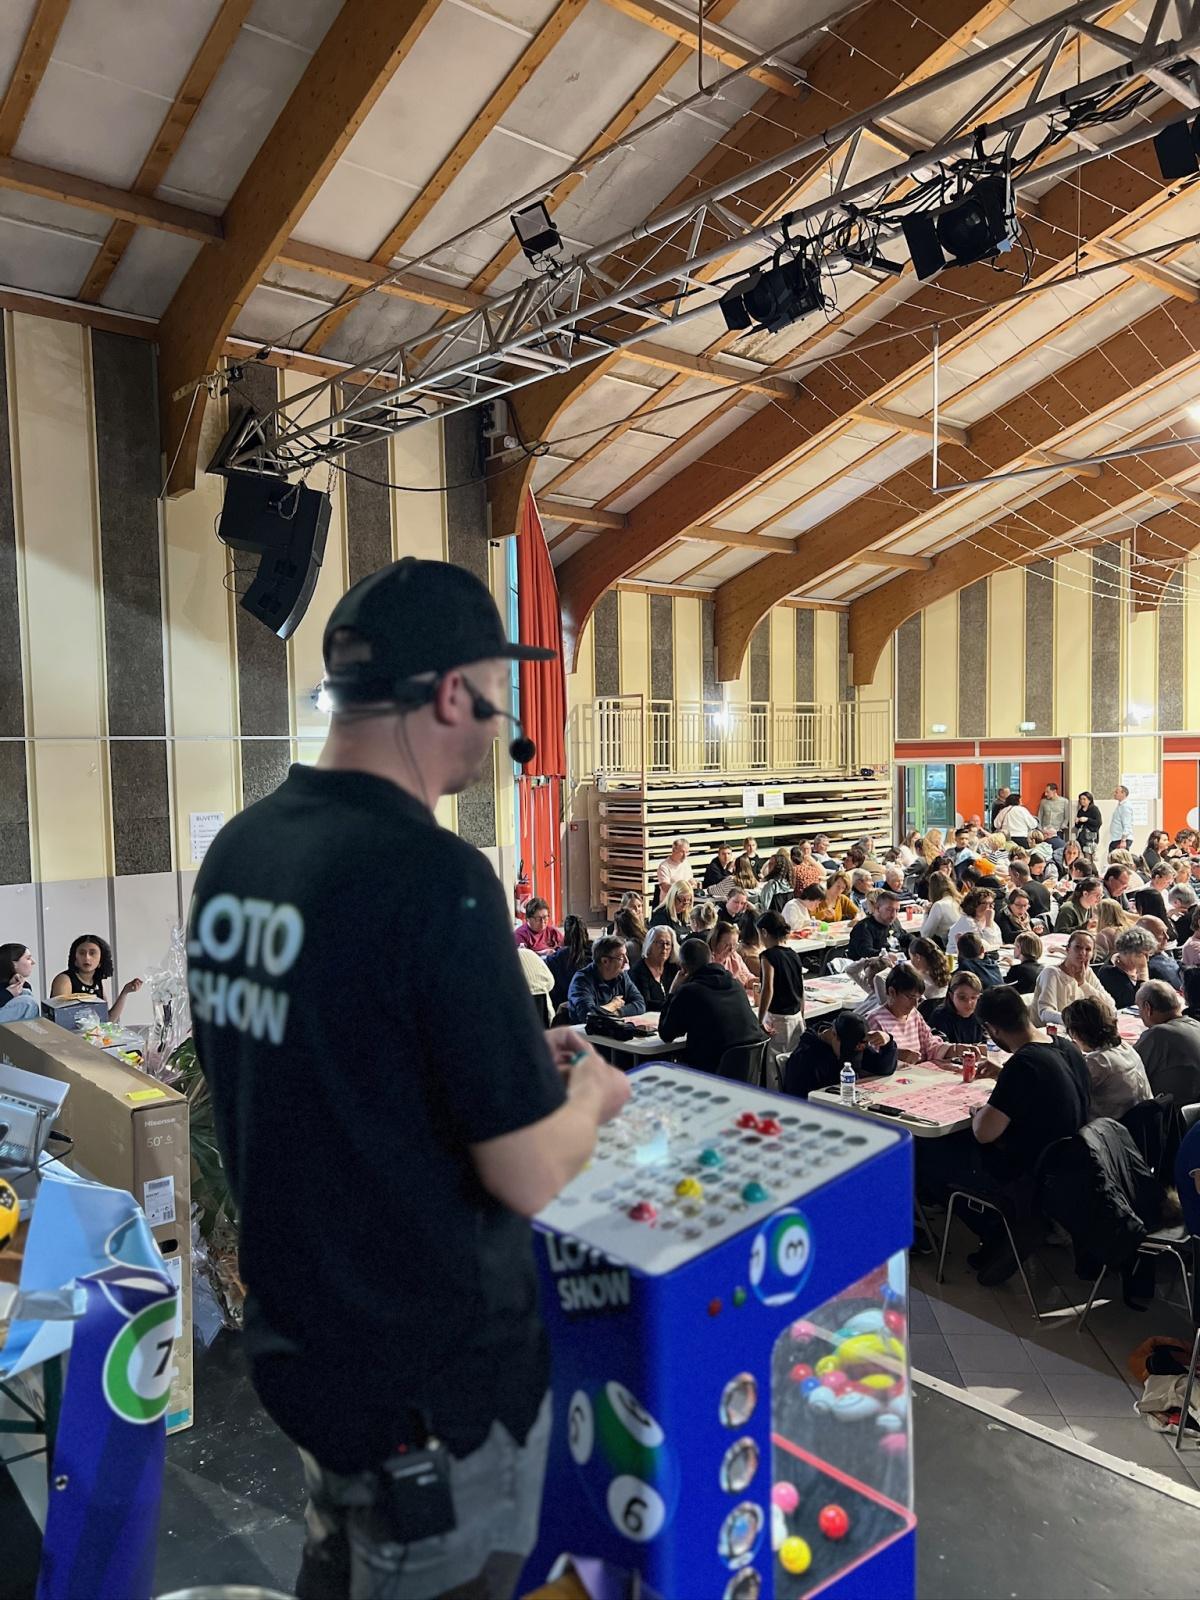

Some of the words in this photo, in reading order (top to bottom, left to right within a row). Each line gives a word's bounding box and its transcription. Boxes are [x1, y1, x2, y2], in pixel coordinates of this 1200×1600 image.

[189, 968, 289, 1045] SHOW
[557, 1269, 629, 1312] SHOW
[152, 1336, 174, 1378] 7
[623, 1496, 648, 1533] 6
